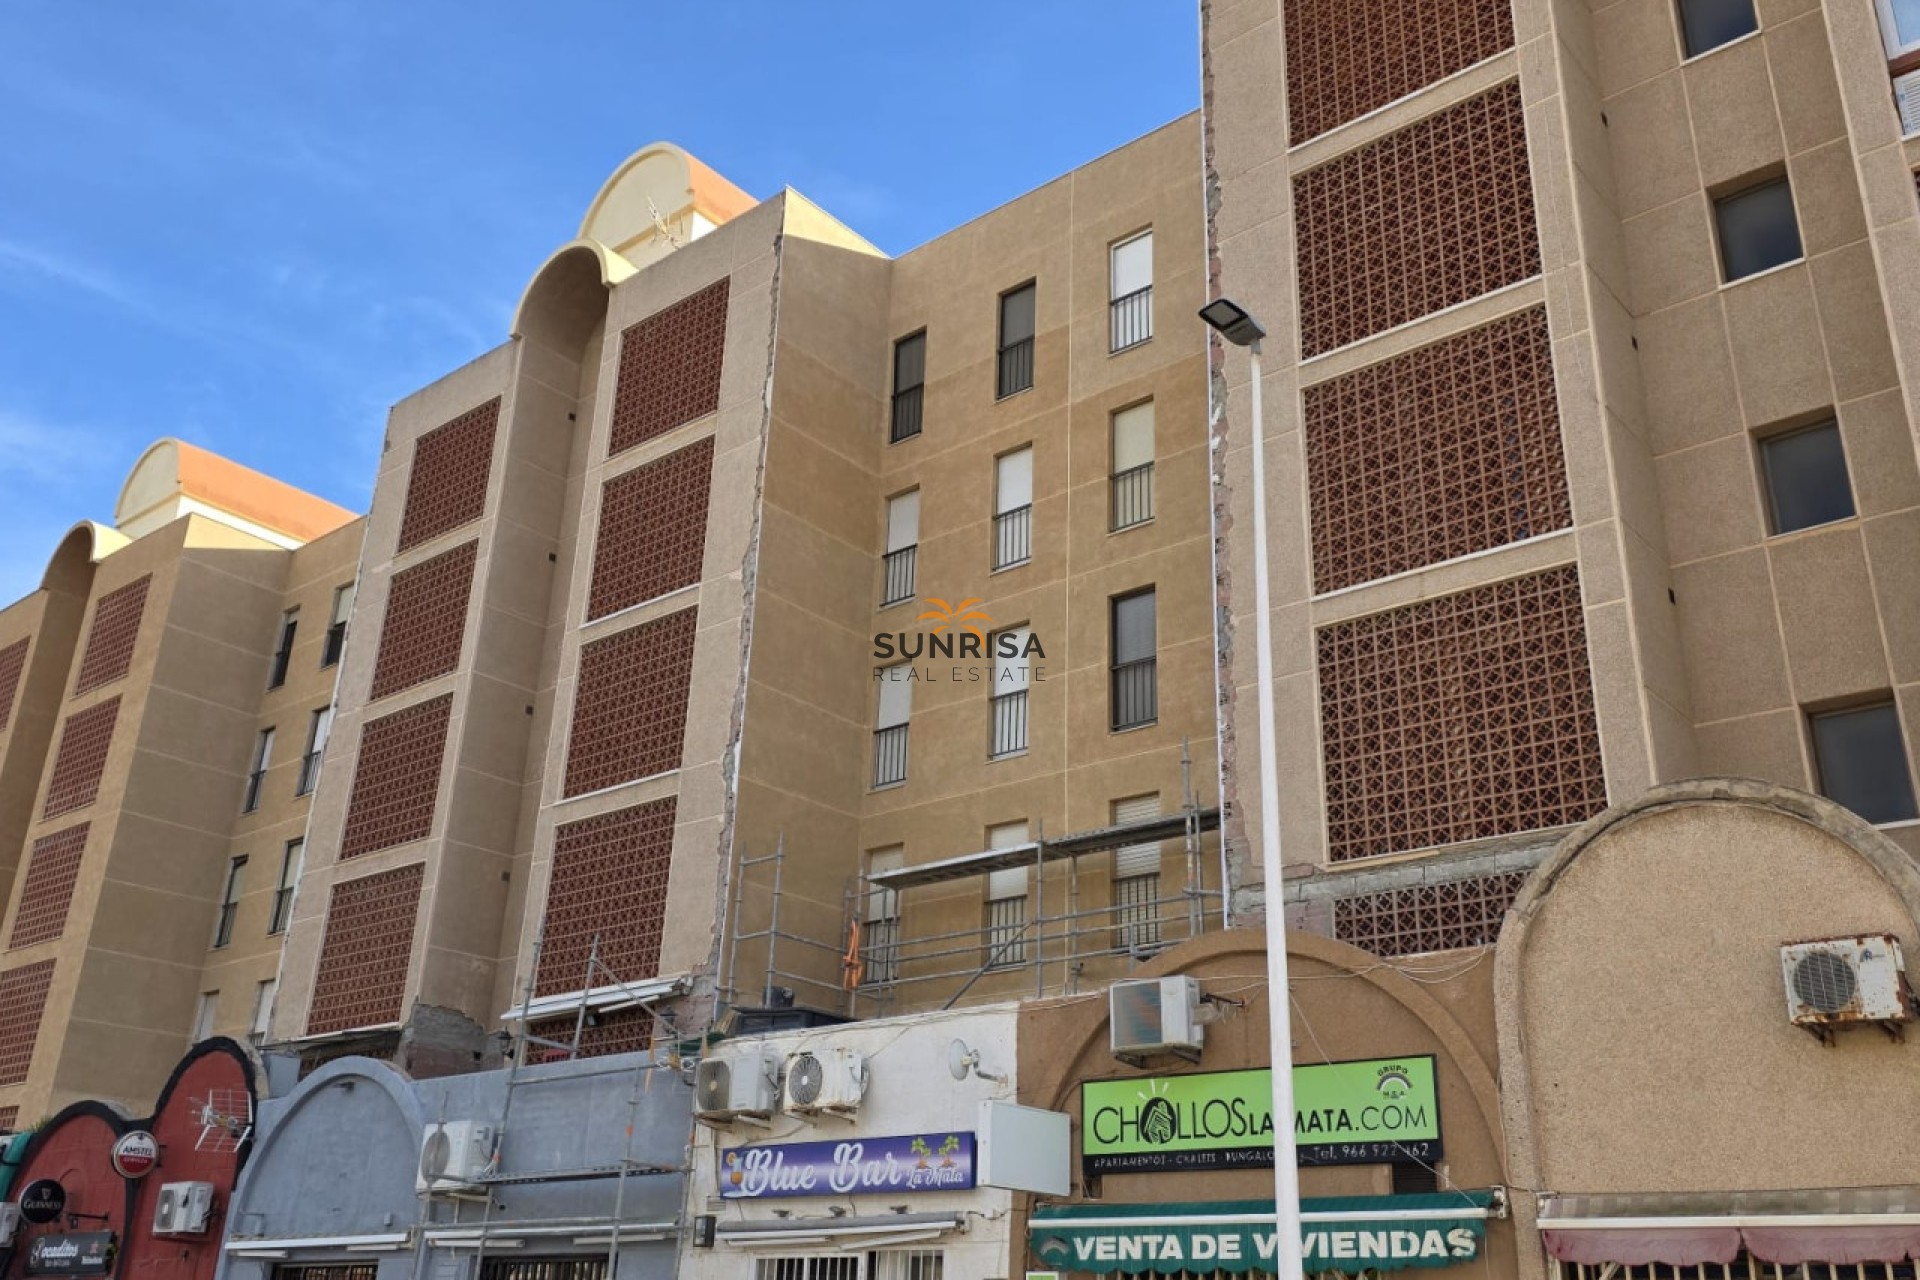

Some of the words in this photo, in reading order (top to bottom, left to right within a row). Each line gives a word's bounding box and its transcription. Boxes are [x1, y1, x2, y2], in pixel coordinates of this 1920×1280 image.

[1377, 1064, 1408, 1077] GRUPO
[122, 1145, 153, 1156] AMSTEL
[1226, 1149, 1275, 1163] BUNGALO
[1342, 1145, 1367, 1158] 966
[742, 1149, 817, 1194] Blue
[829, 1142, 902, 1192] Bar
[906, 1167, 923, 1188] La
[925, 1167, 964, 1186] Mata
[1073, 1235, 1183, 1260] VENTA
[1191, 1234, 1243, 1260] DE
[1252, 1229, 1477, 1260] VVIENDAS
